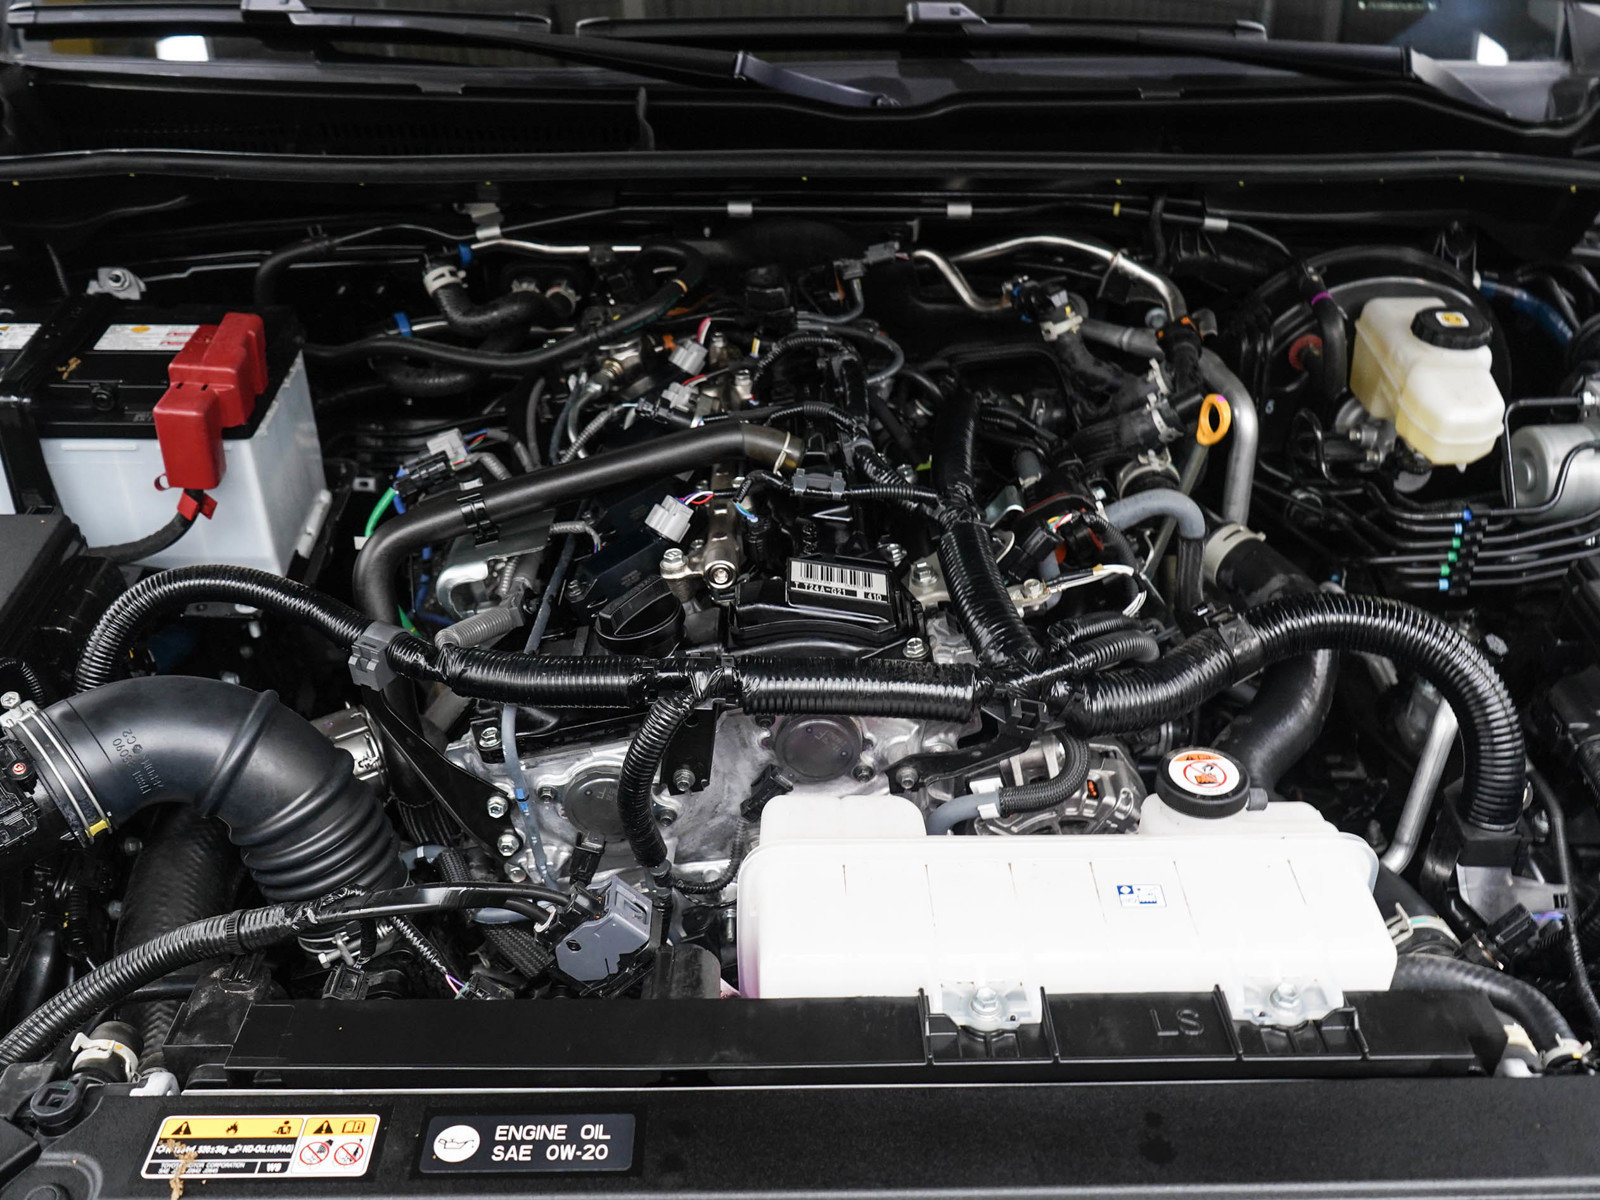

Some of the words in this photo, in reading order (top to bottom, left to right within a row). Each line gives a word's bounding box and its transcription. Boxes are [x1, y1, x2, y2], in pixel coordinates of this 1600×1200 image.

[494, 1124, 567, 1141] ENGINE
[580, 1124, 611, 1140] OIL
[491, 1145, 533, 1162] SAE
[546, 1144, 609, 1161] 0W-20
